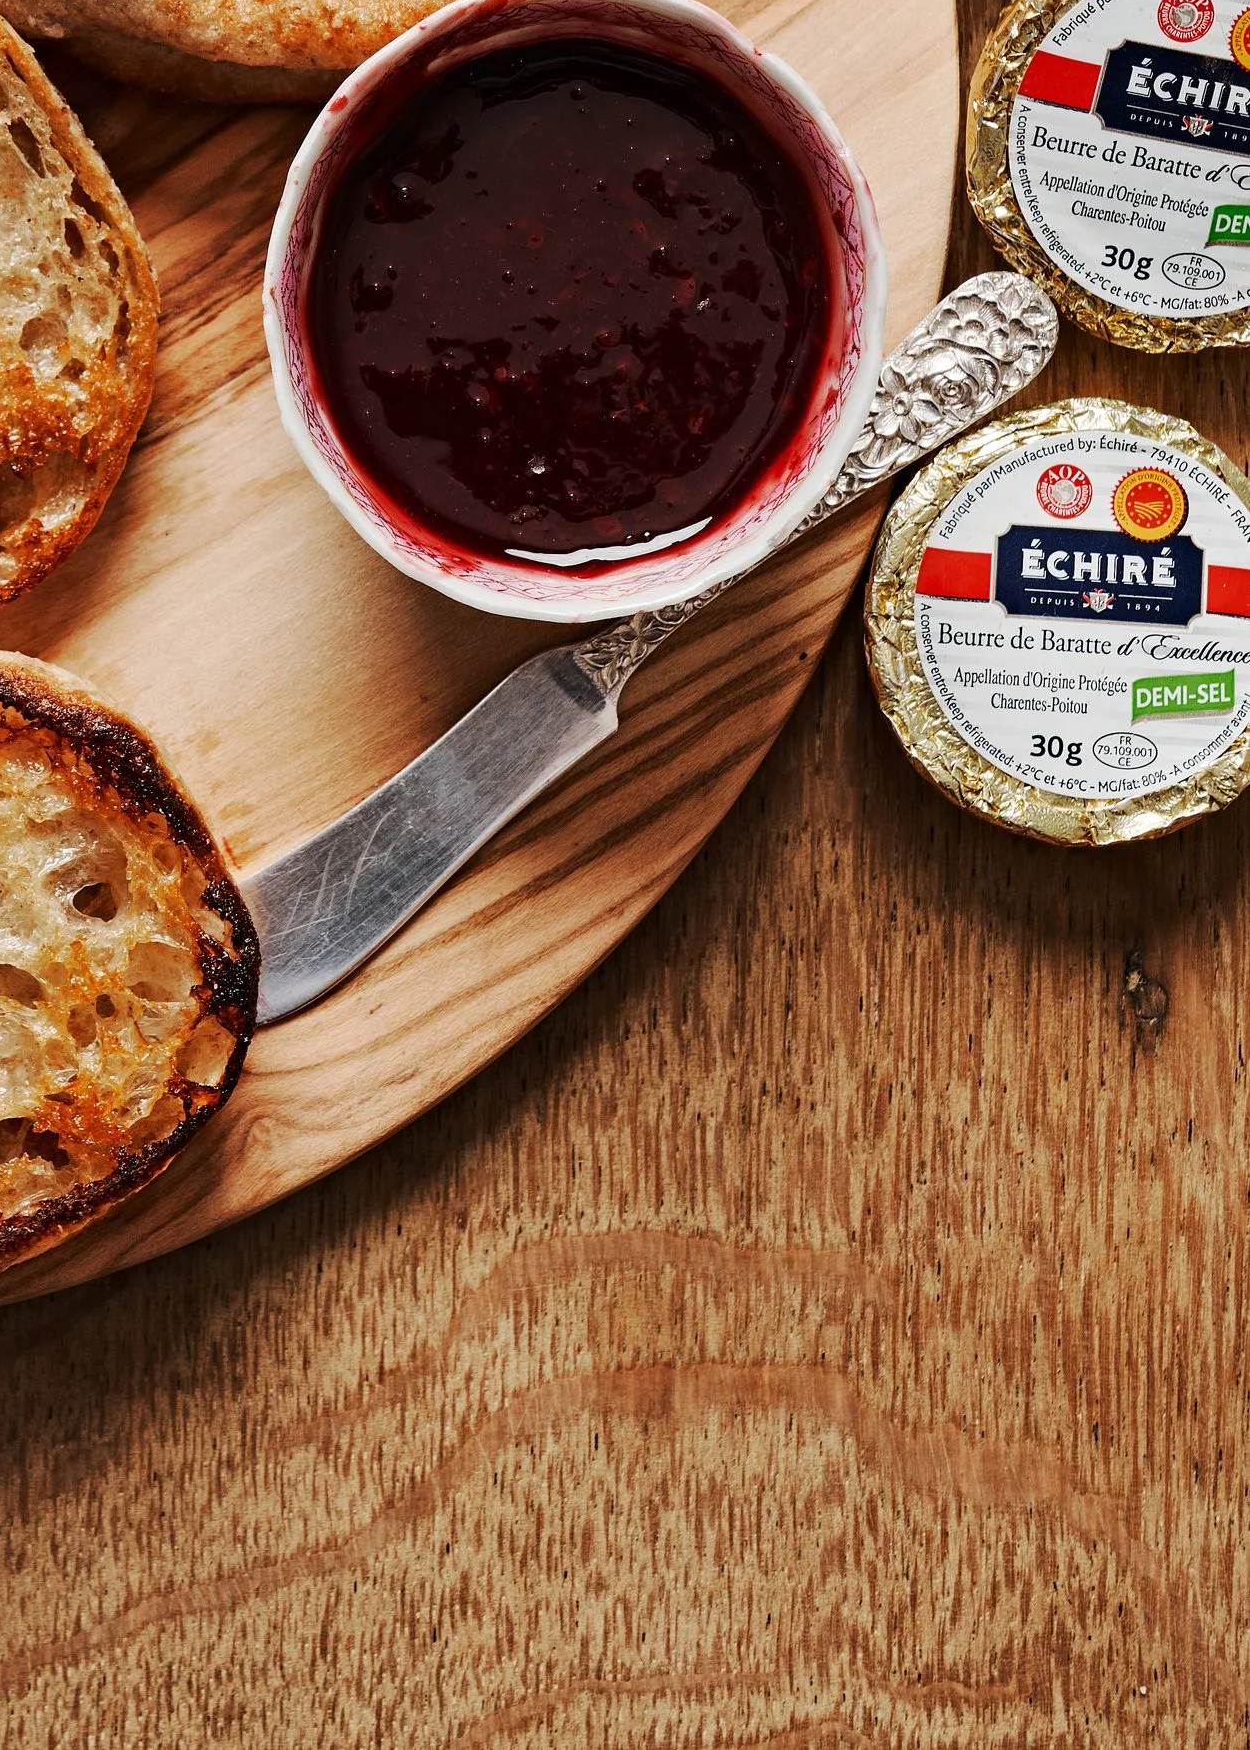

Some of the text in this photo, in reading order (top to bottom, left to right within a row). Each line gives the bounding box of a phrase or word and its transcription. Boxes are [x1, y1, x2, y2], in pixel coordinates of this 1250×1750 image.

[1052, 2, 1096, 46] Fabriqué
[1126, 57, 1250, 117] ÉCHIR
[1019, 104, 1032, 113] A
[1016, 115, 1028, 165] conserver
[1130, 114, 1248, 141] DEPUIS 189
[1031, 126, 1098, 159] Beurre
[1102, 141, 1127, 164] de
[1130, 146, 1202, 178] Baratte
[1018, 168, 1044, 223] entre/Keep
[1040, 171, 1209, 218] Appellation d'Origine Protégée
[1072, 200, 1166, 232] Charentes-Poitou
[1040, 222, 1086, 274] refrigerated:
[1189, 256, 1203, 267] FR
[1101, 245, 1154, 280] 30g
[1166, 262, 1221, 281] 79.109.001
[1110, 285, 1122, 297] et
[1184, 276, 1198, 287] CE
[1161, 298, 1202, 310] MG/fat:
[1204, 293, 1229, 308] 80%
[939, 492, 976, 540] Fabriqué
[975, 438, 1074, 498] par/Manufactured
[1077, 438, 1096, 453] by:
[1100, 435, 1138, 453] Échiré
[1150, 447, 1189, 472] 79410
[1188, 466, 1230, 504] ÉCHIRÉ
[1048, 465, 1085, 484] AOP
[1116, 478, 1137, 520] APPELLATION
[1138, 473, 1173, 488] D'ORIGINE
[1021, 538, 1176, 587] ÉCHIRÉ
[921, 603, 932, 611] A
[1030, 596, 1161, 611] DEPUIS 1894
[920, 613, 937, 665] conserver
[938, 622, 1005, 647] Beurre
[1011, 627, 1035, 650] de
[1040, 629, 1111, 654] Baratte
[931, 667, 964, 721] entre/Keep
[954, 667, 1128, 696] Appellation d'Origine Protégée
[991, 692, 1088, 714] Charentes-Poitou
[1136, 683, 1231, 708] DEMI-SEL
[961, 720, 1015, 767] refrigerated:
[1097, 745, 1153, 757] 79.109.001
[1119, 736, 1132, 745] FR
[1183, 725, 1234, 770] consommer
[1118, 757, 1131, 766] CE
[1044, 775, 1056, 786] et
[1098, 780, 1141, 793] MG/fat:
[1141, 770, 1167, 787] 80%
